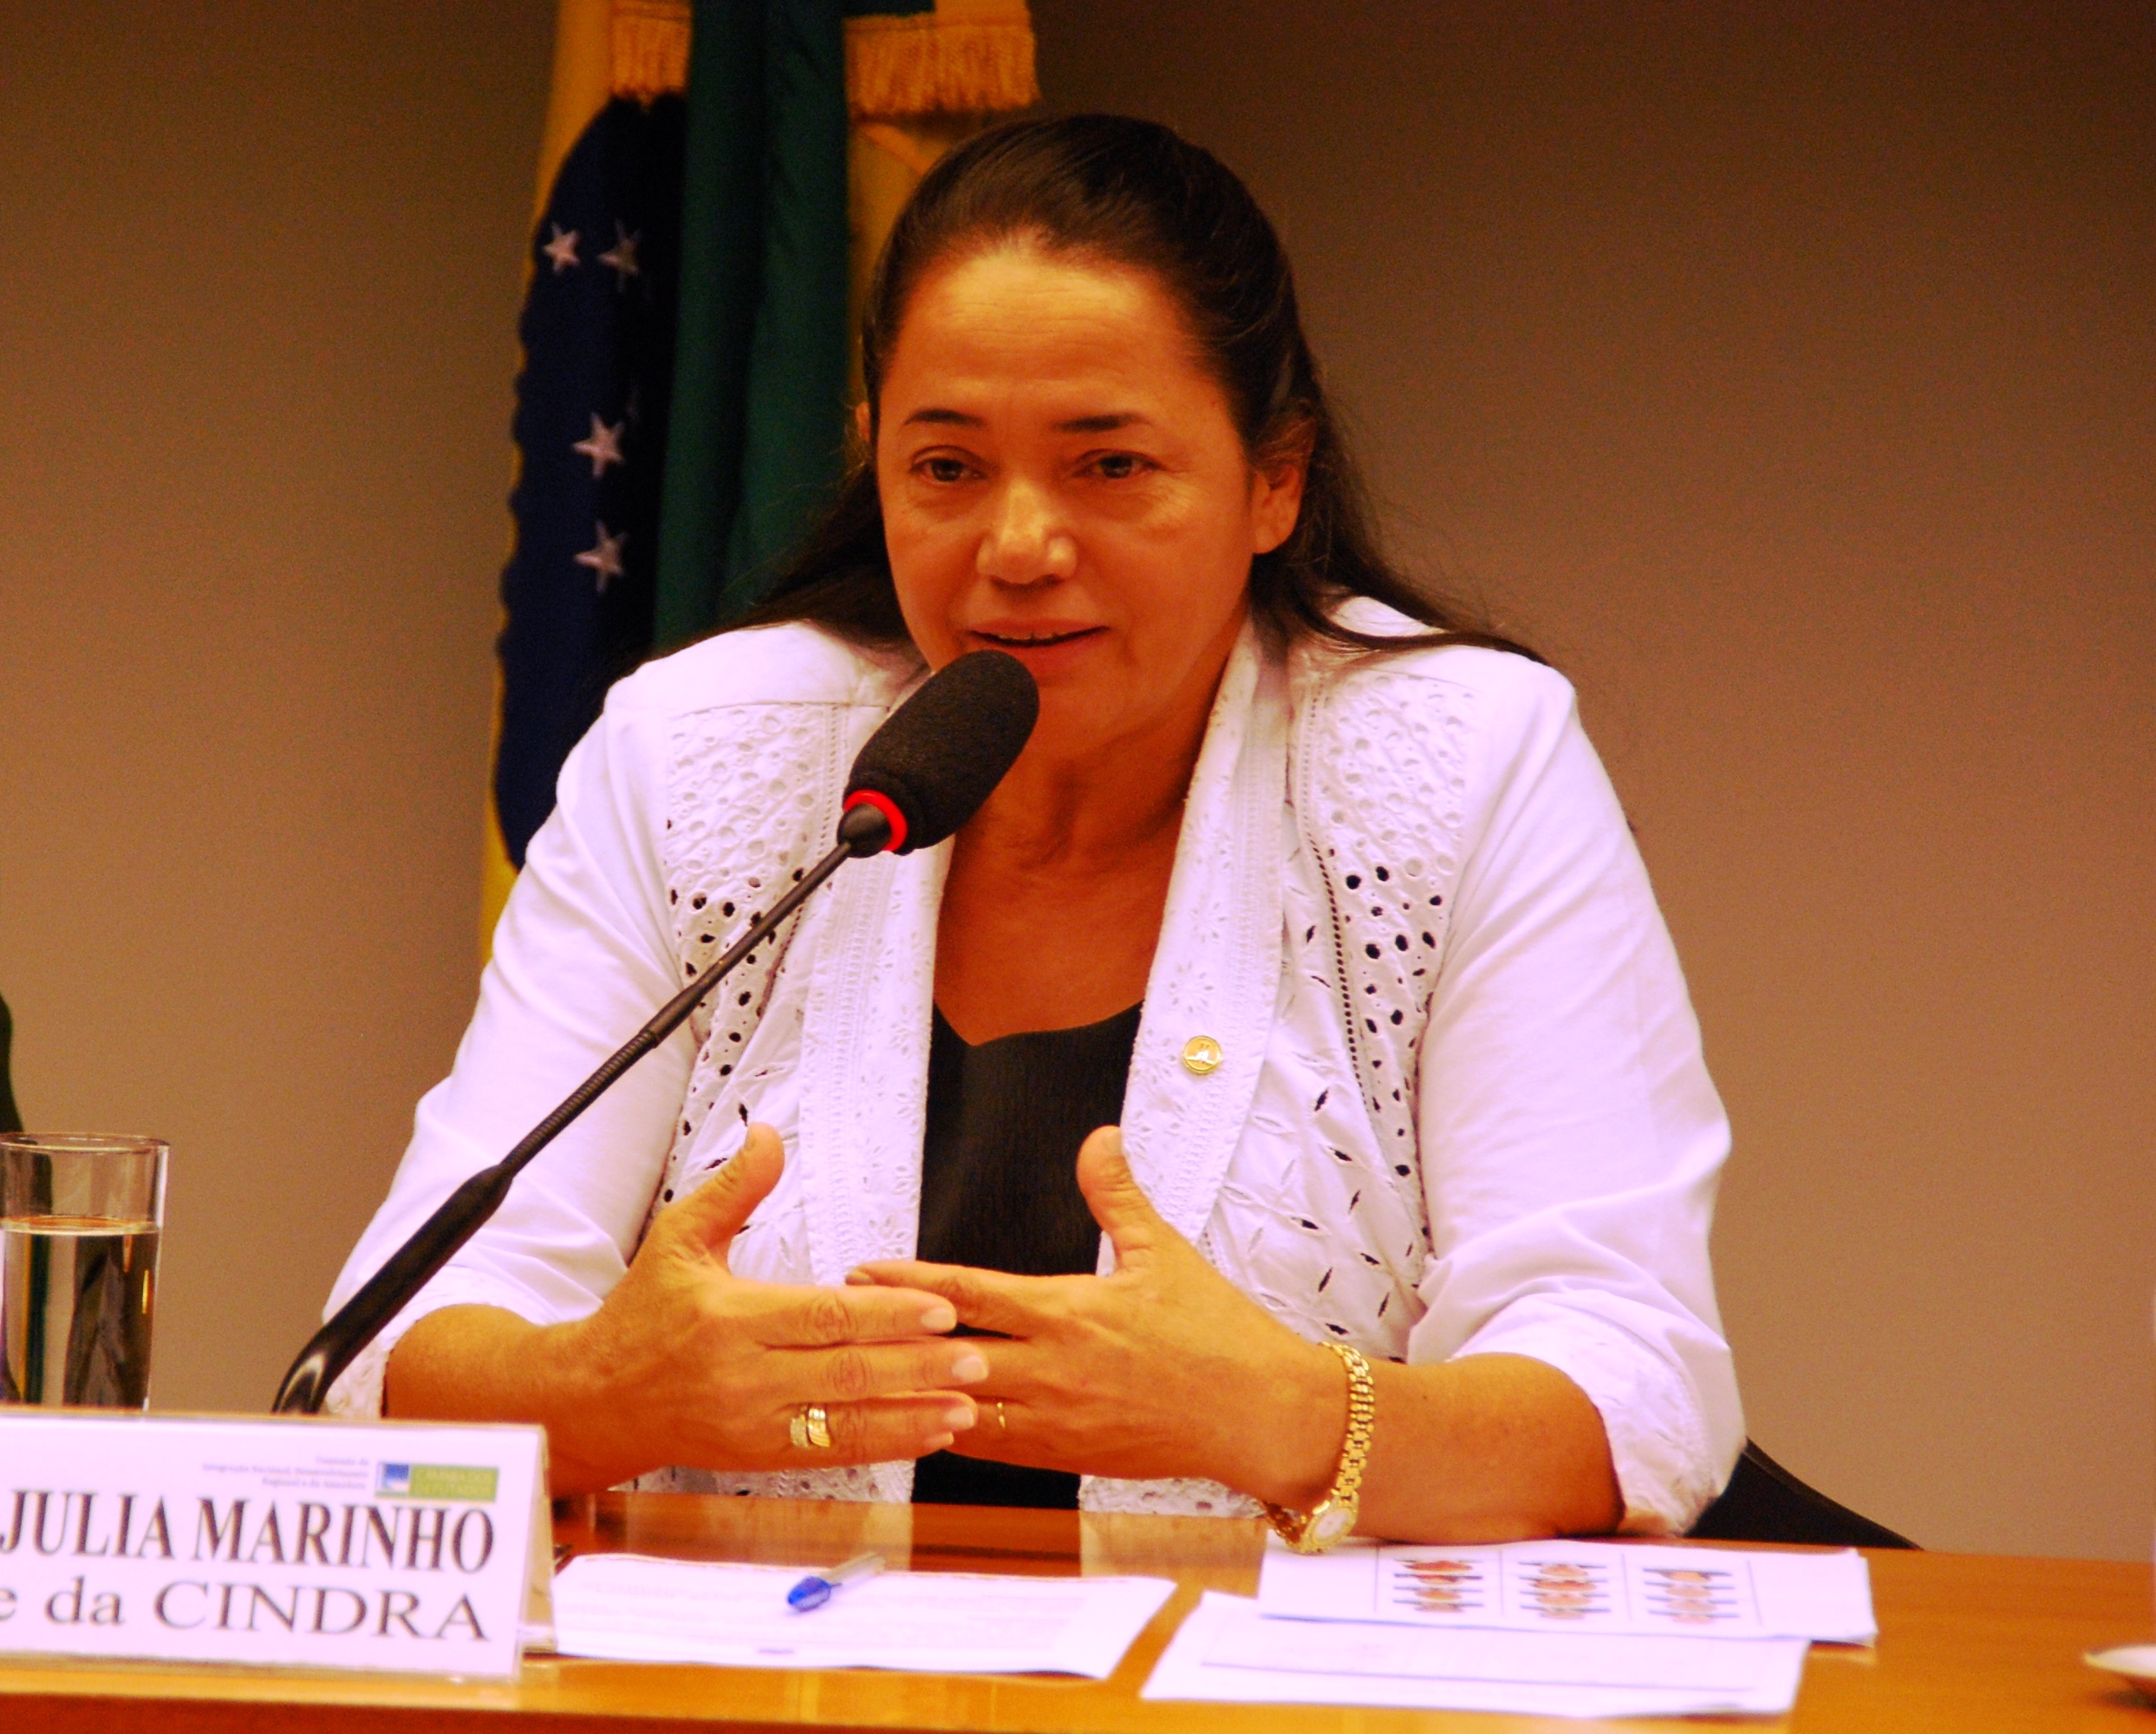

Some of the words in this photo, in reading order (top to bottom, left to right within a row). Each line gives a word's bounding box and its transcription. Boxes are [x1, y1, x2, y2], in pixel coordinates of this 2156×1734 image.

[0, 1489, 174, 1560] JULIA
[192, 1496, 495, 1574] MARINHO
[44, 1574, 126, 1626] da
[153, 1579, 492, 1641] CINDRA
